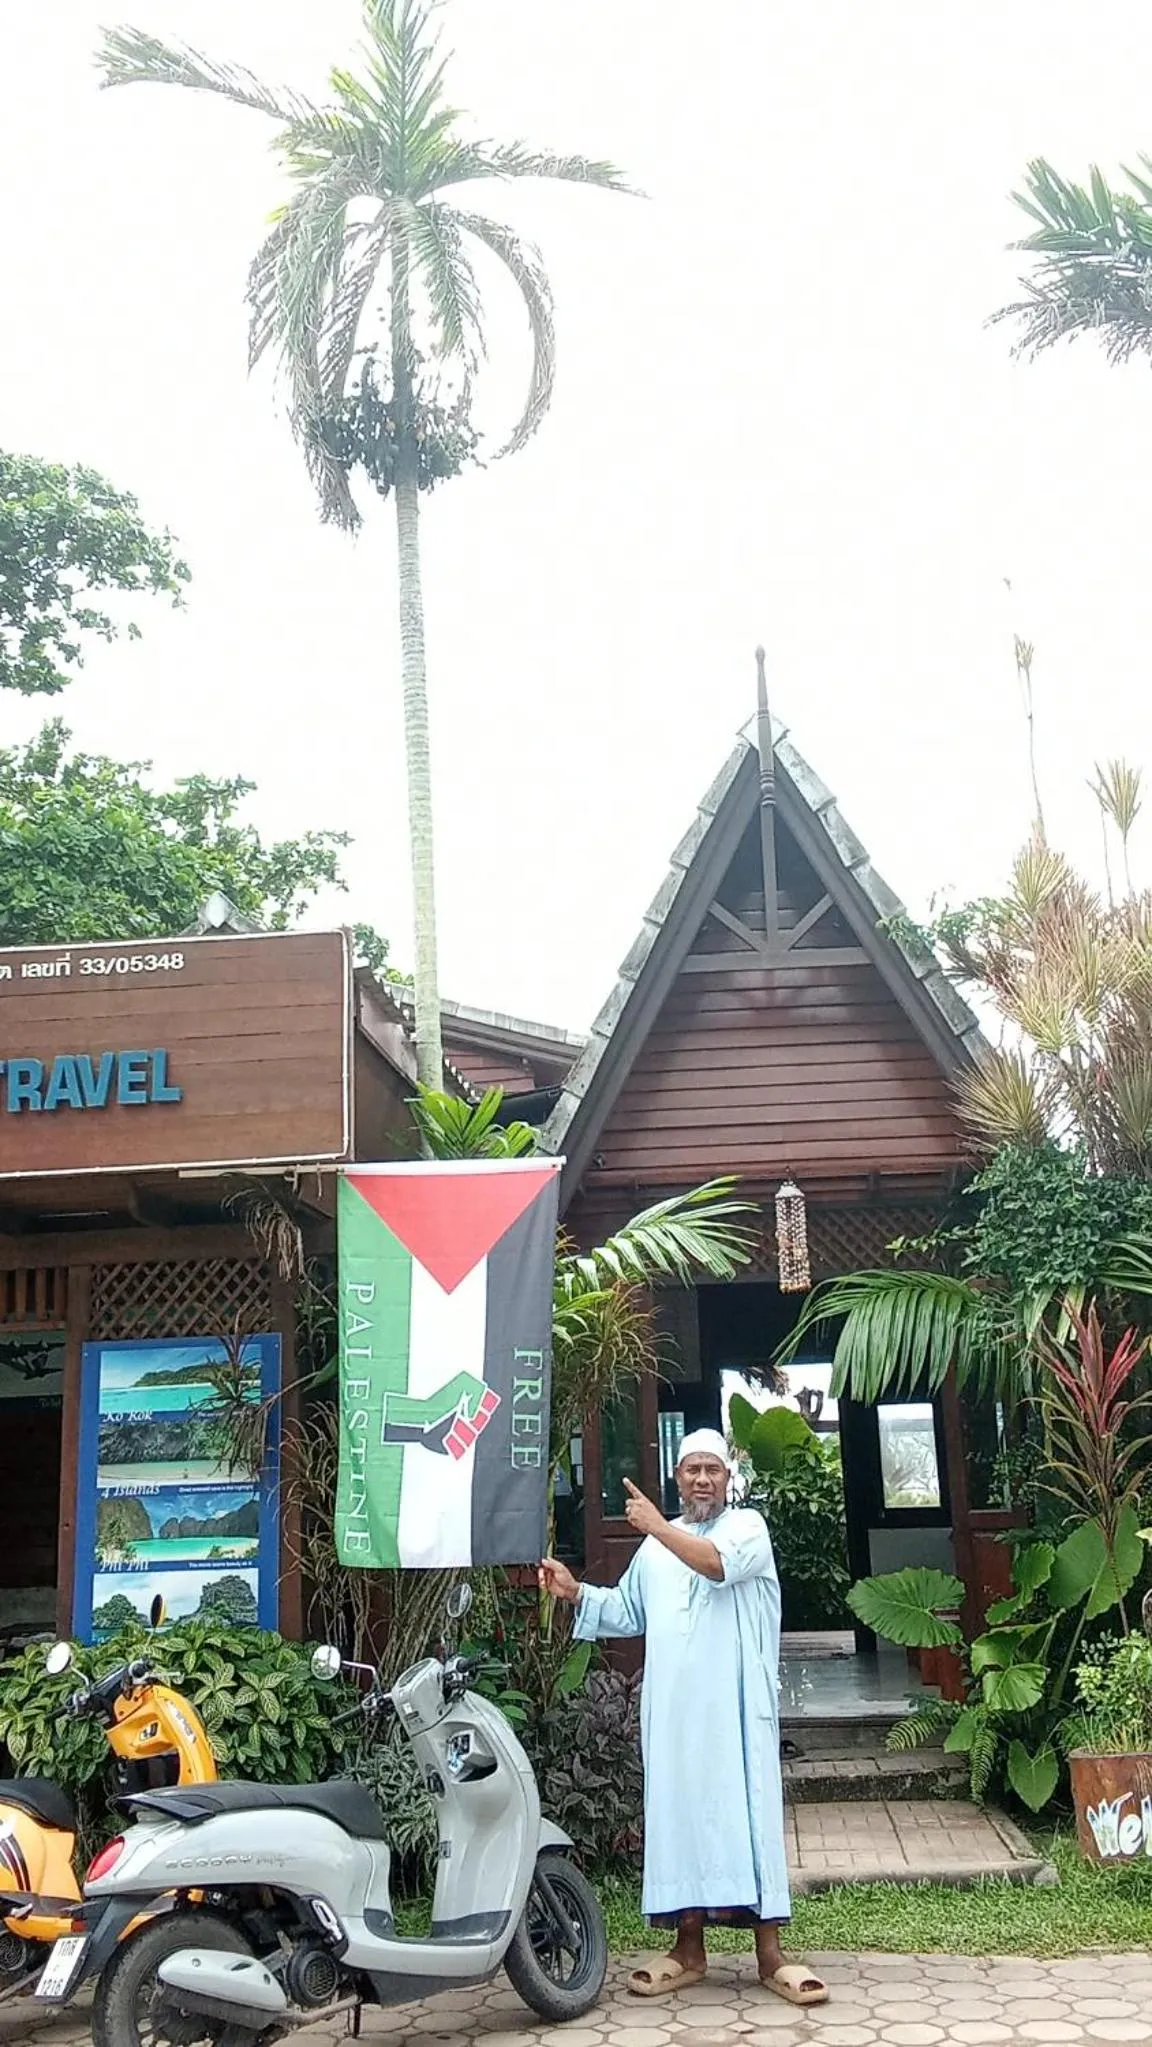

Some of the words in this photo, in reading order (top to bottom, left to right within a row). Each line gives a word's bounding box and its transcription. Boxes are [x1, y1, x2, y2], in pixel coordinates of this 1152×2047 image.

[22, 953, 71, 978] เลขที่
[79, 953, 184, 975] 33/05348
[0, 1048, 183, 1112] RAVEL
[344, 1280, 375, 1553] PALESTINE
[511, 1347, 543, 1470] FREE
[113, 1481, 160, 1497] Islands
